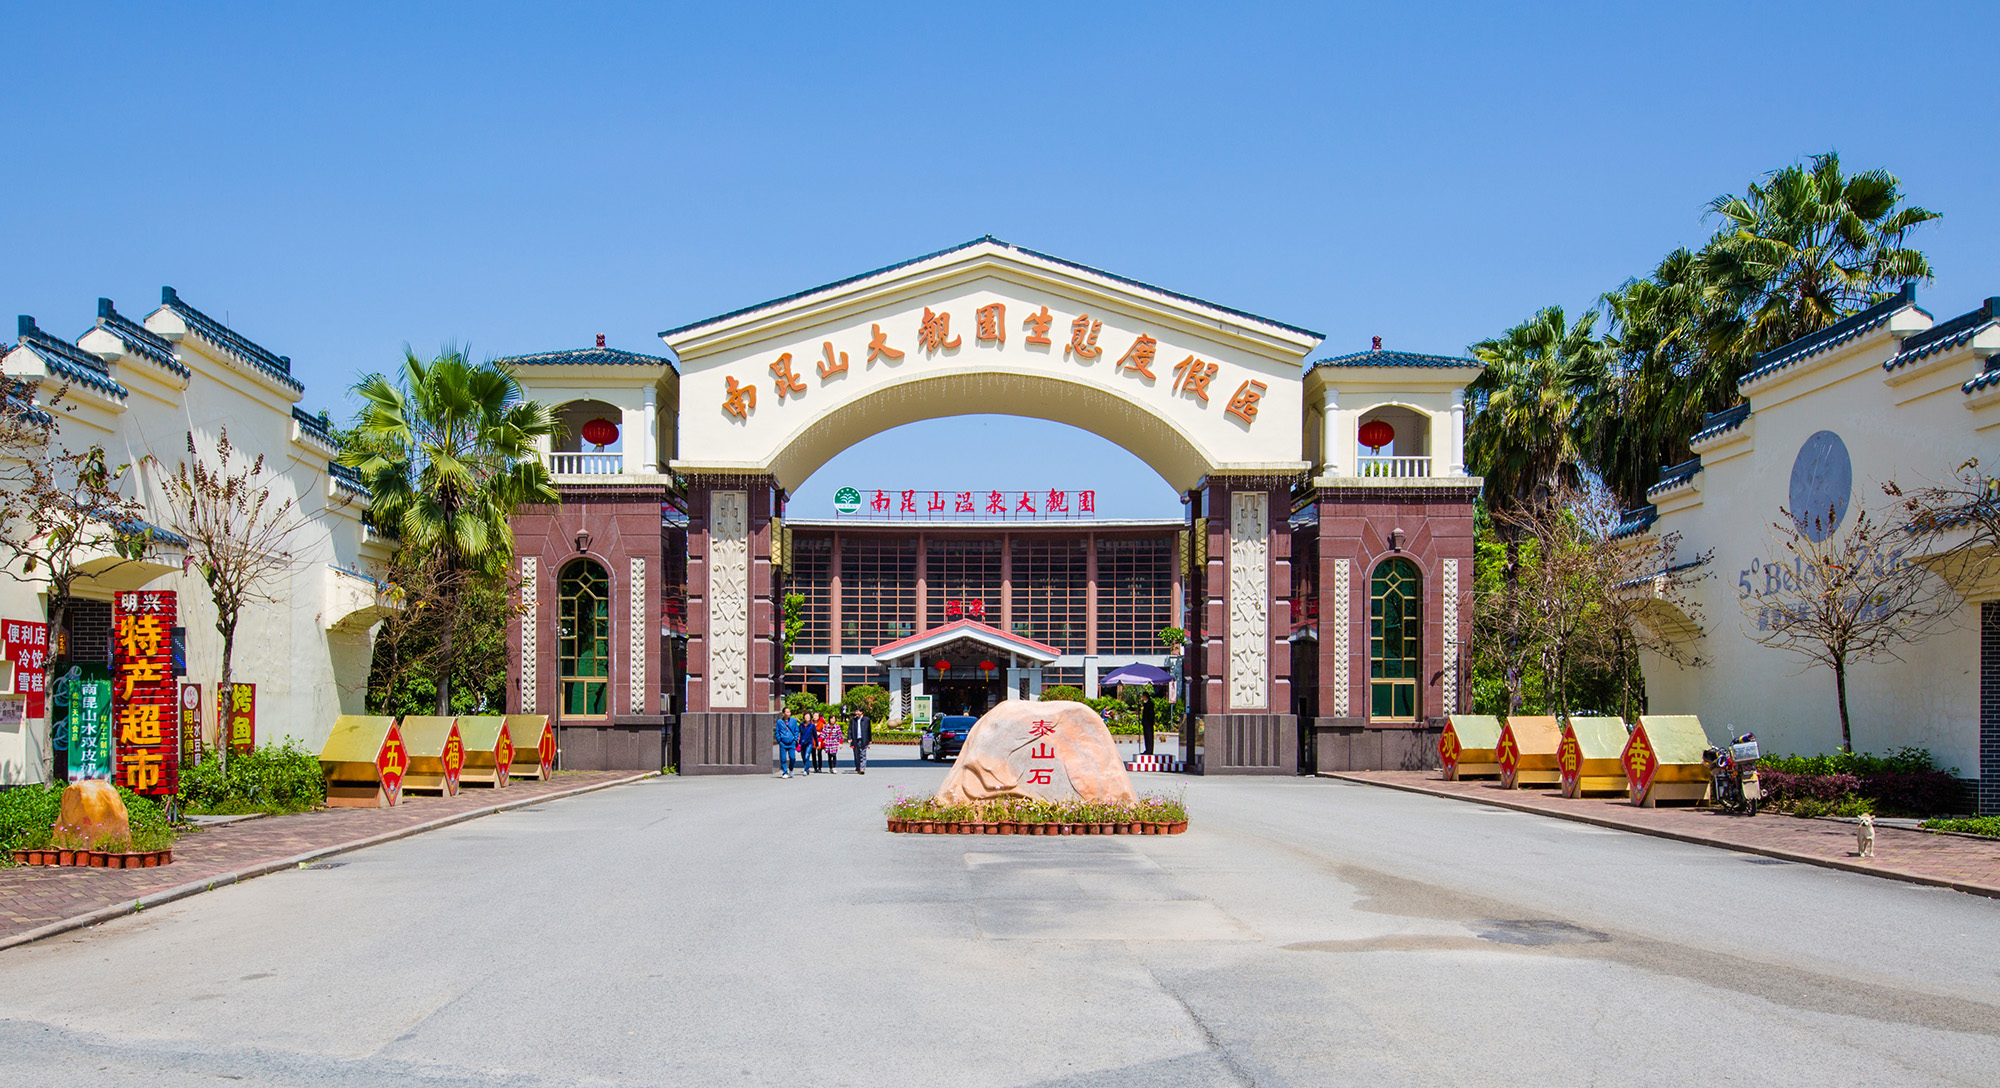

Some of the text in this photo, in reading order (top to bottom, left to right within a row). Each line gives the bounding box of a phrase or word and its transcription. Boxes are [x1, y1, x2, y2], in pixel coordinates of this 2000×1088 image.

[121, 593, 162, 612] 明兴
[946, 598, 986, 617] 温泉
[7, 623, 46, 645] 便利店
[18, 649, 43, 668] 冷饮
[18, 672, 43, 692] 雪糕
[120, 614, 164, 790] 特产超市
[231, 683, 253, 745] 烤鱼
[81, 683, 98, 774] 南昆山水双皮奶
[1442, 731, 1457, 760] 观
[382, 739, 402, 777] 五
[446, 736, 460, 770] 福
[1026, 719, 1056, 785] 泰山石
[1500, 734, 1515, 766] 大
[1562, 737, 1576, 771] 福
[1628, 736, 1650, 778] 幸
